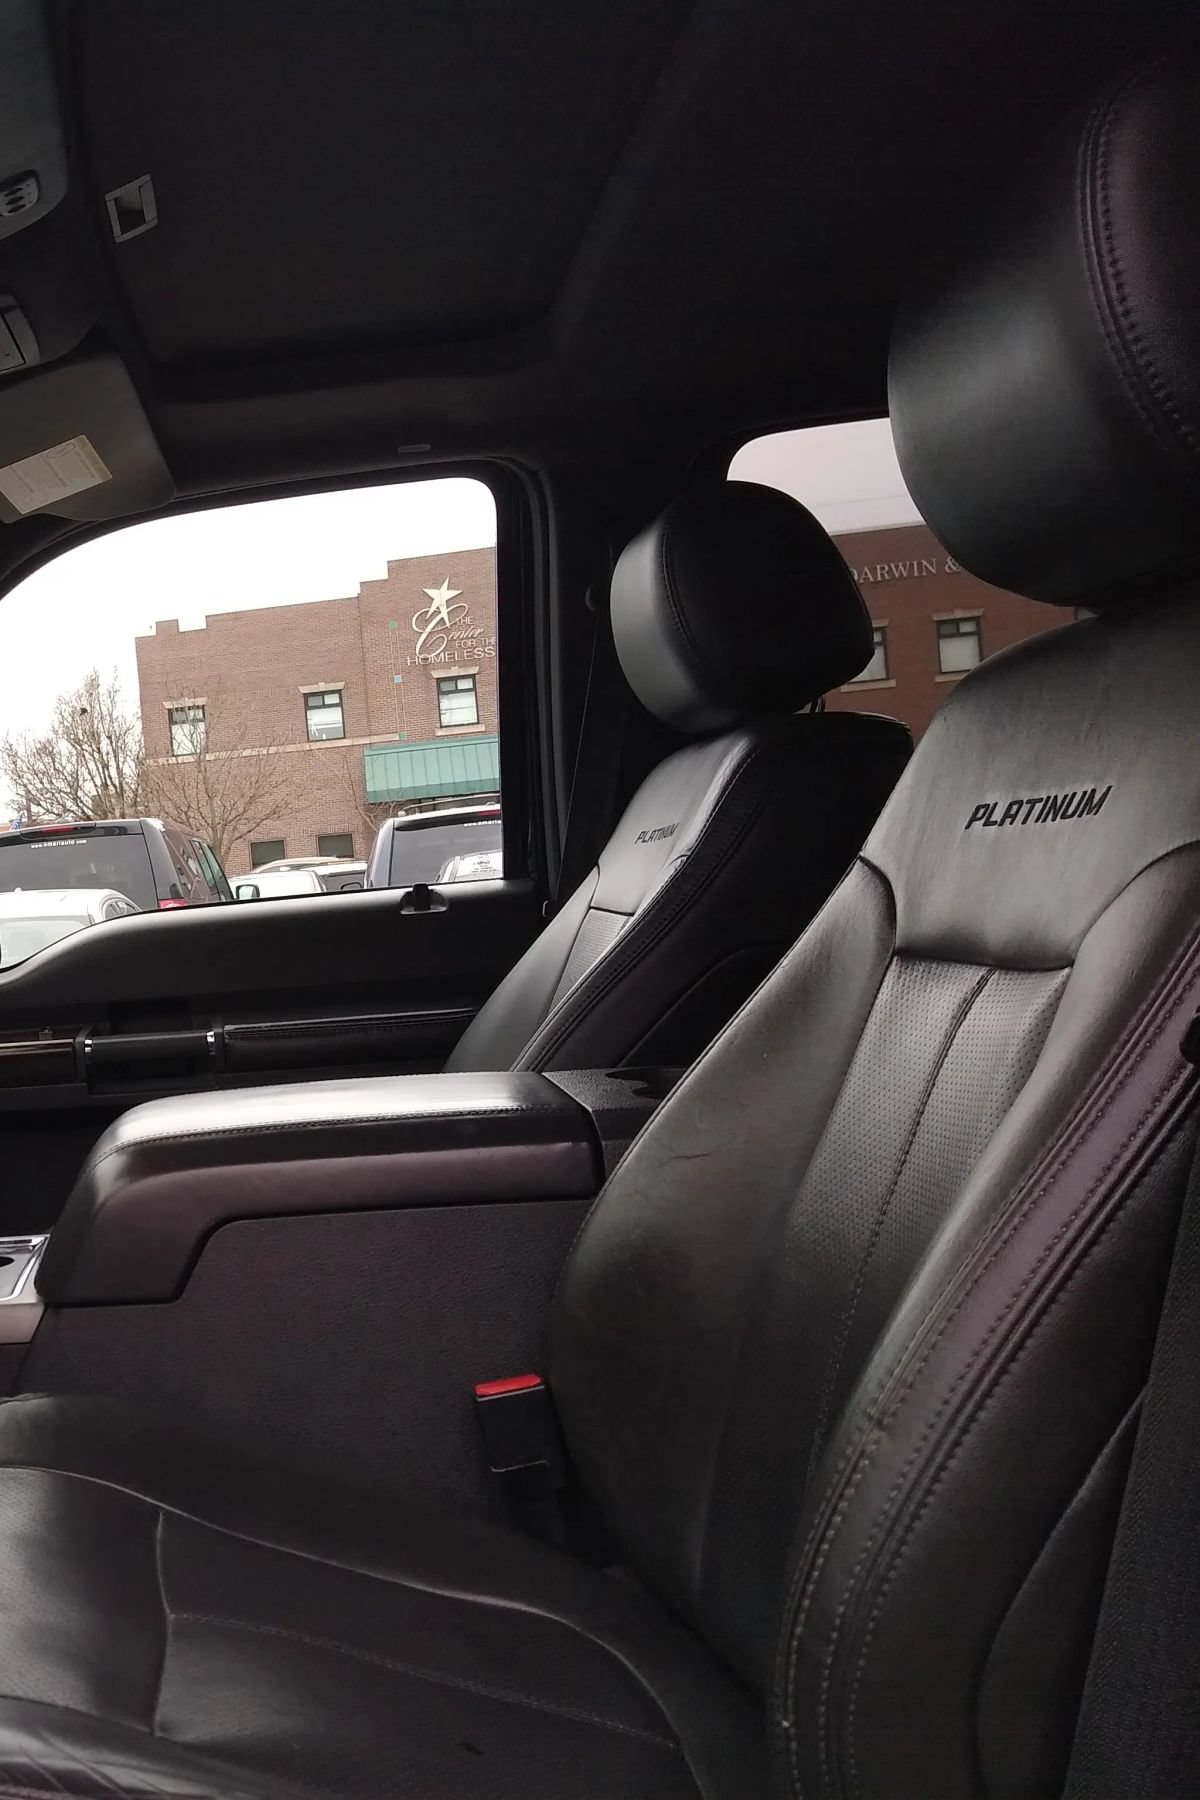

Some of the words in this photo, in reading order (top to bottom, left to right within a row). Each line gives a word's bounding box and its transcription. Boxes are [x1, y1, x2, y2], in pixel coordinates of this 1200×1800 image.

[456, 639, 476, 649] FOR
[407, 646, 496, 667] HOMELESS
[964, 785, 1114, 831] PLATINUM
[634, 822, 680, 845] PLATINUM
